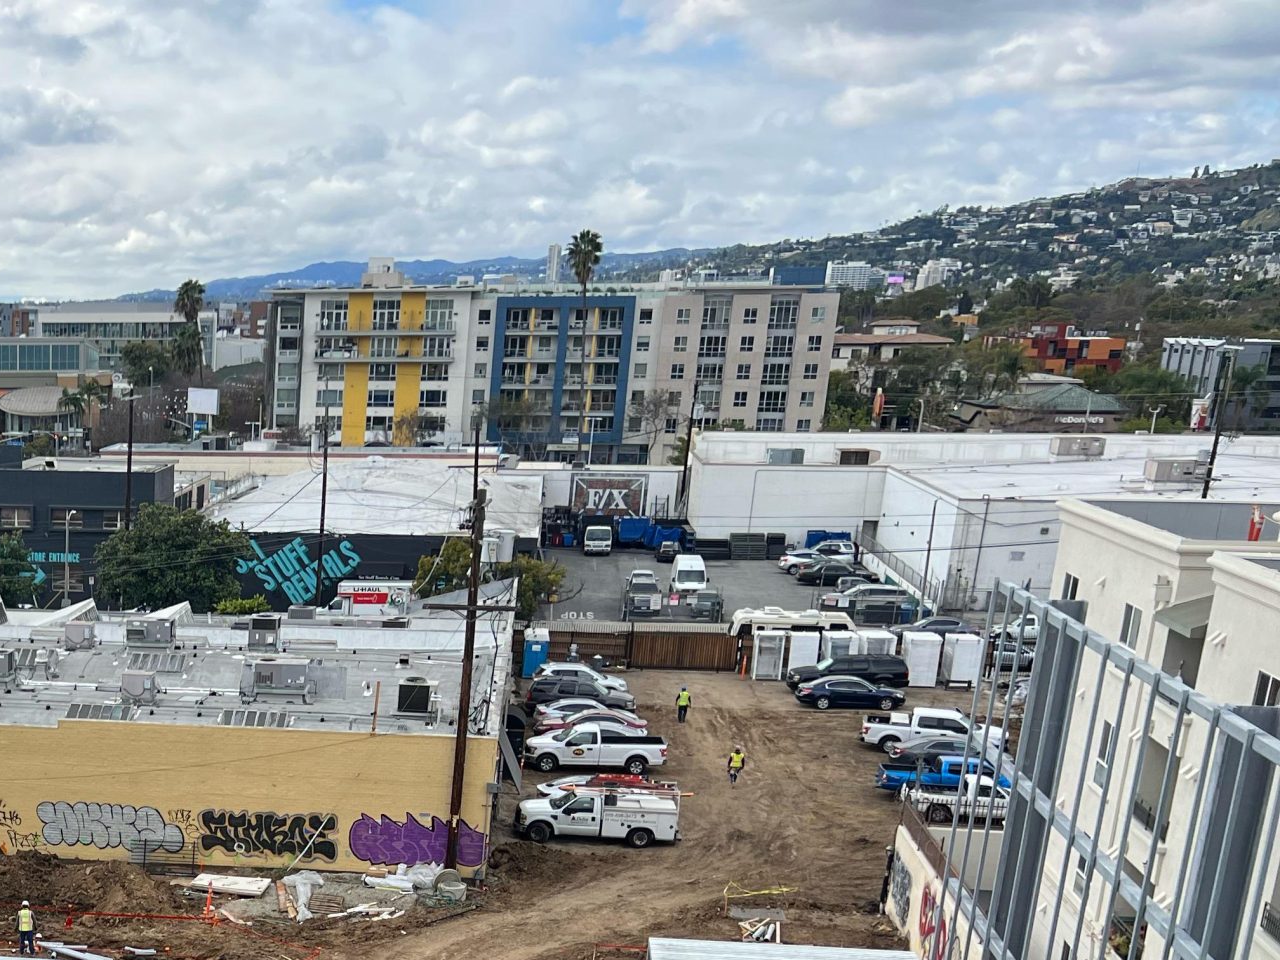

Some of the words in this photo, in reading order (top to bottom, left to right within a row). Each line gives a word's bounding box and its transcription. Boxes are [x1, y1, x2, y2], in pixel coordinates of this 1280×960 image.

[586, 488, 629, 510] F/X
[254, 536, 311, 591] STUFF
[560, 611, 594, 620] STOP
